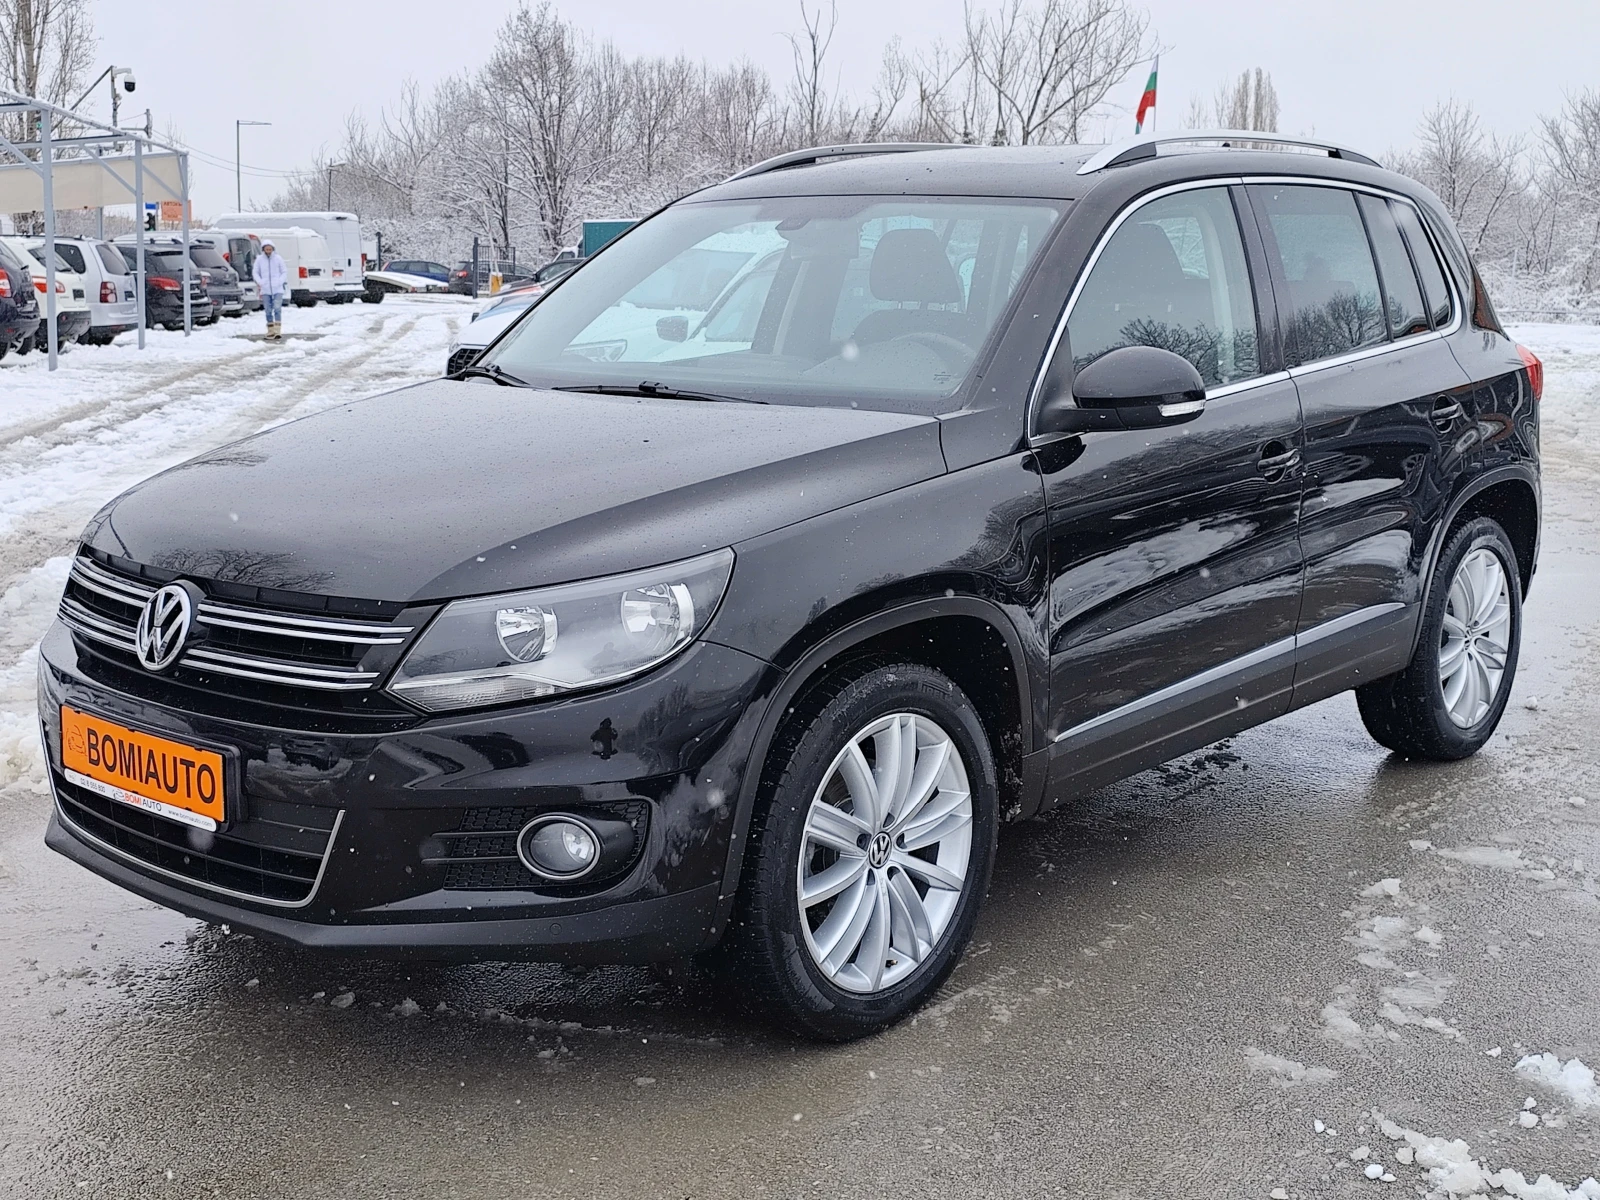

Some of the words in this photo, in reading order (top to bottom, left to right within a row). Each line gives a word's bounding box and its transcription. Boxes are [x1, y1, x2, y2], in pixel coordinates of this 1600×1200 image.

[86, 727, 216, 804] BOMIAUTO
[124, 792, 142, 805] BOMI
[142, 799, 162, 812] AUTO
